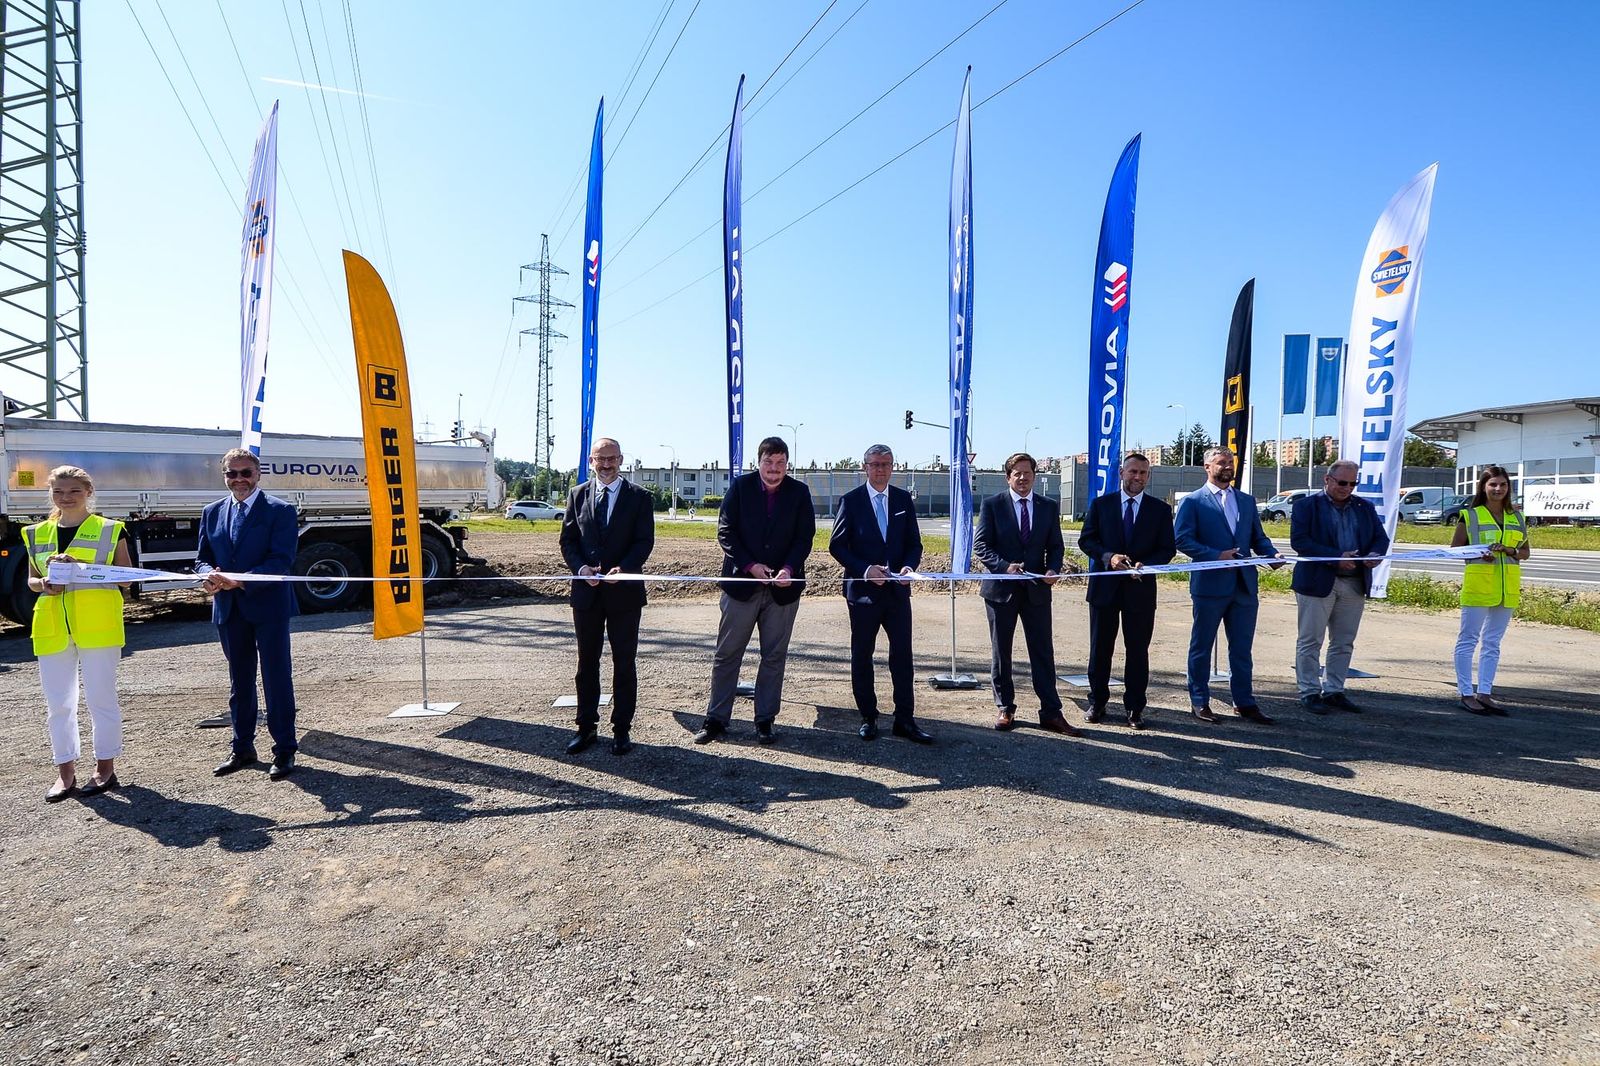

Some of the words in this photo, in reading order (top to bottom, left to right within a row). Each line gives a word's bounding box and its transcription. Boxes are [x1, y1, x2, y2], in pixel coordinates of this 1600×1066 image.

[1373, 263, 1411, 281] SWIETELSKY
[375, 372, 397, 401] B
[1097, 326, 1119, 497] UROVIA
[1357, 317, 1398, 524] IETELSKY
[260, 463, 359, 476] EUROVIA
[381, 427, 411, 605] BERGER
